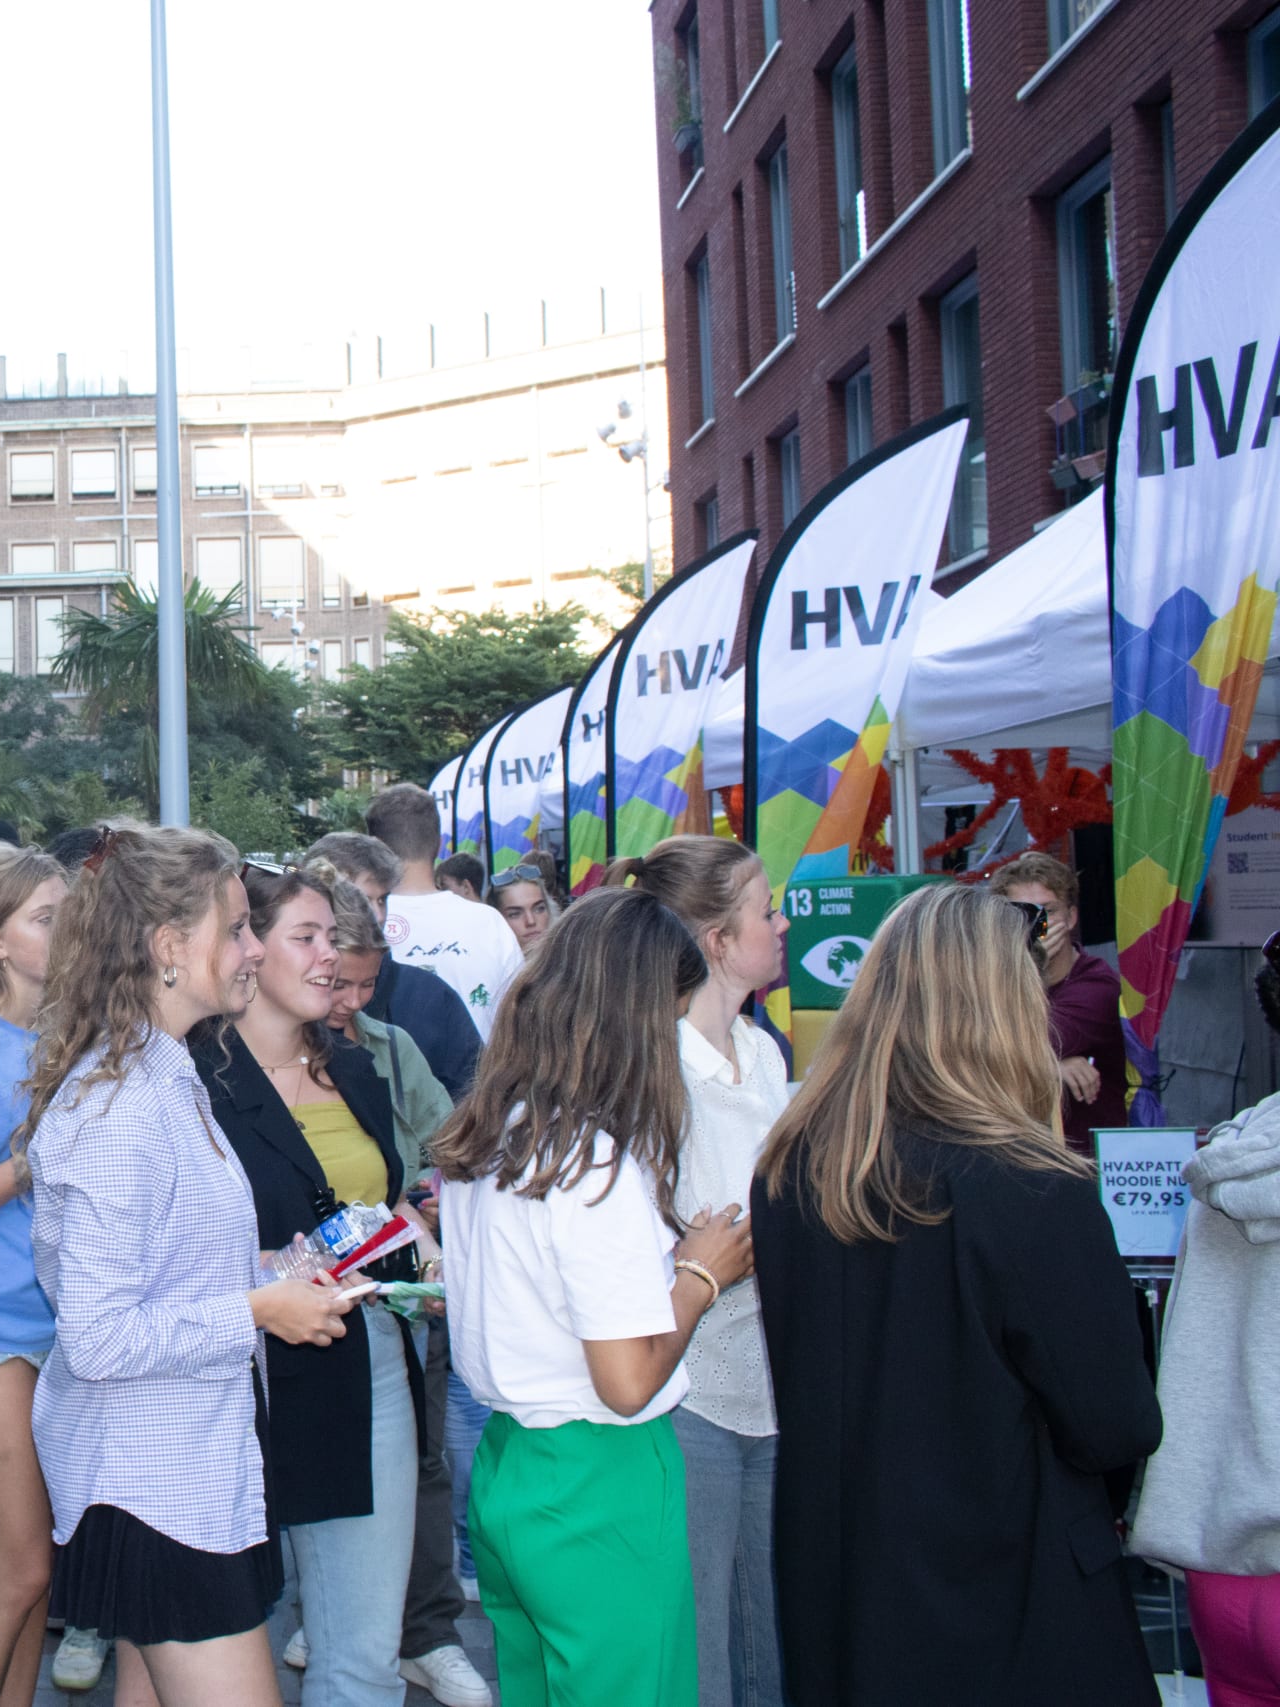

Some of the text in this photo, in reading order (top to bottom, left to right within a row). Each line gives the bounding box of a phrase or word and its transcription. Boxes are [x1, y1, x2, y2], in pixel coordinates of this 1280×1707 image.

[1227, 832, 1268, 842] Student
[818, 887, 854, 900] CLIMATE
[787, 888, 812, 917] 13
[819, 904, 851, 916] ACTION
[1106, 1176, 1162, 1187] HOODIE
[1112, 1192, 1185, 1208] €79,95
